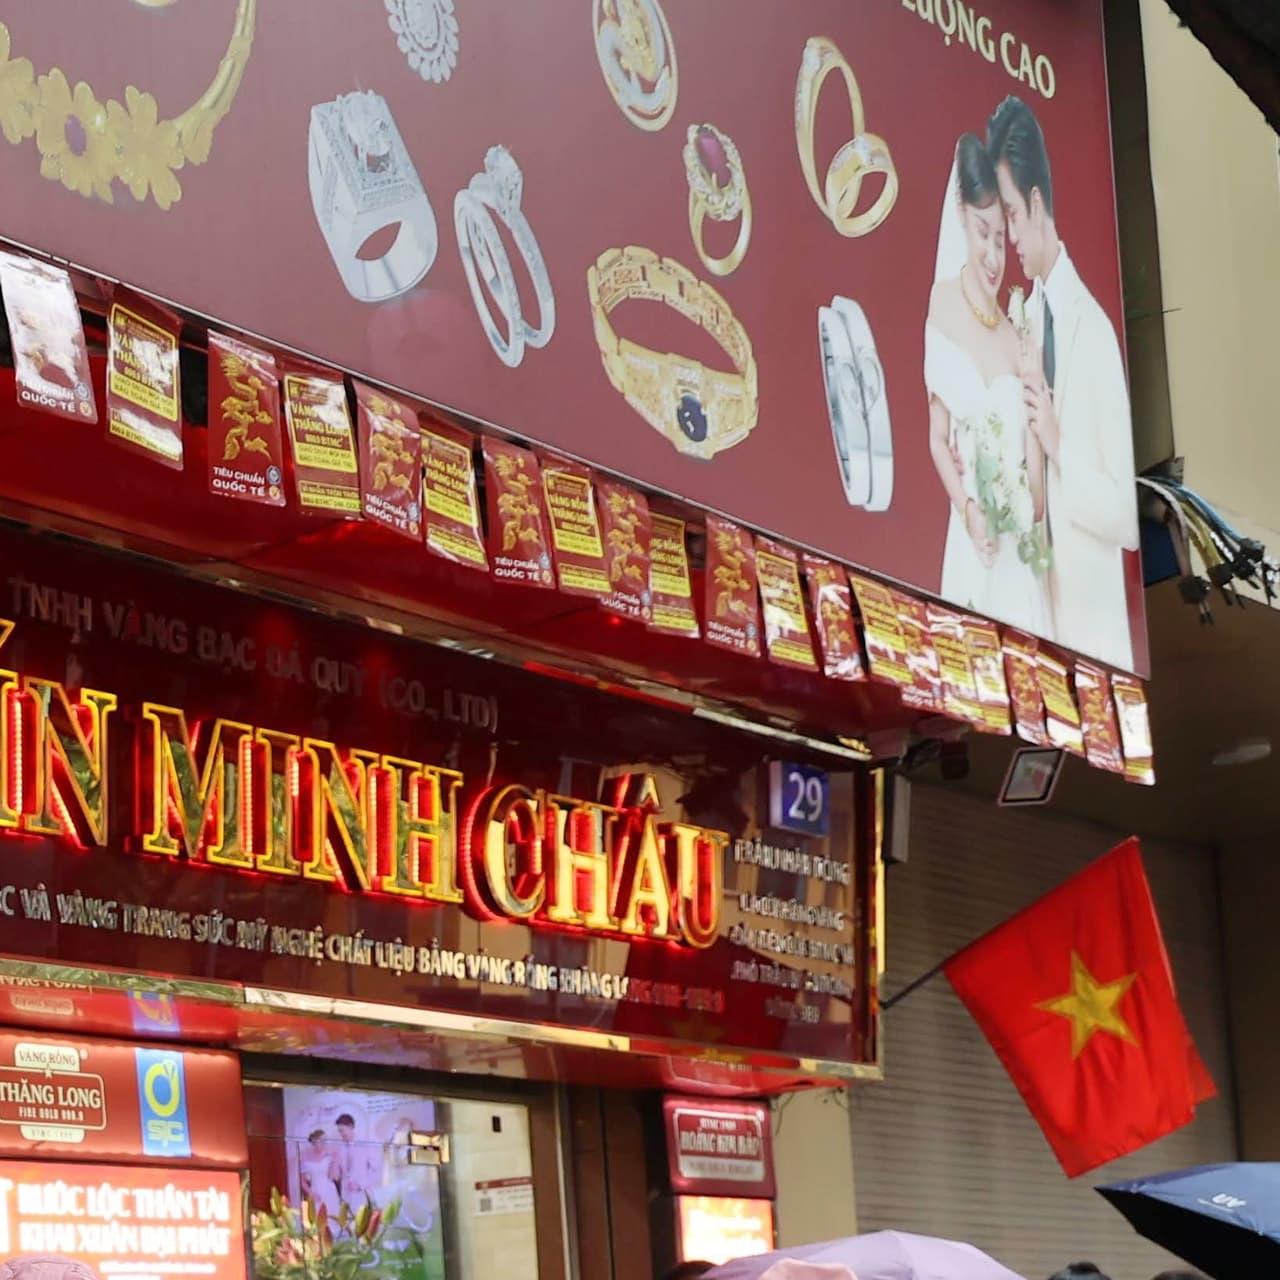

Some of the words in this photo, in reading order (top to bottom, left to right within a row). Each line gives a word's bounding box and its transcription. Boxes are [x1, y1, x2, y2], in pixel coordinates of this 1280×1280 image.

[1000, 32, 1055, 99] CAO
[212, 478, 247, 494] QUỐC
[250, 483, 265, 497] TẾ
[213, 466, 233, 481] TIÊU
[234, 469, 265, 485] CHUẨN
[788, 771, 824, 823] 29
[142, 701, 465, 904] MINH
[482, 771, 731, 950] CHÂU
[19, 882, 52, 922] VÀ
[56, 888, 120, 932] VÀNG
[121, 902, 192, 941] TRANG
[192, 908, 234, 947] SỨC
[325, 928, 375, 967] CHẤT
[375, 936, 416, 977] LIỆU
[19, 1049, 48, 1064] VÀNG
[57, 1084, 102, 1109] LONG
